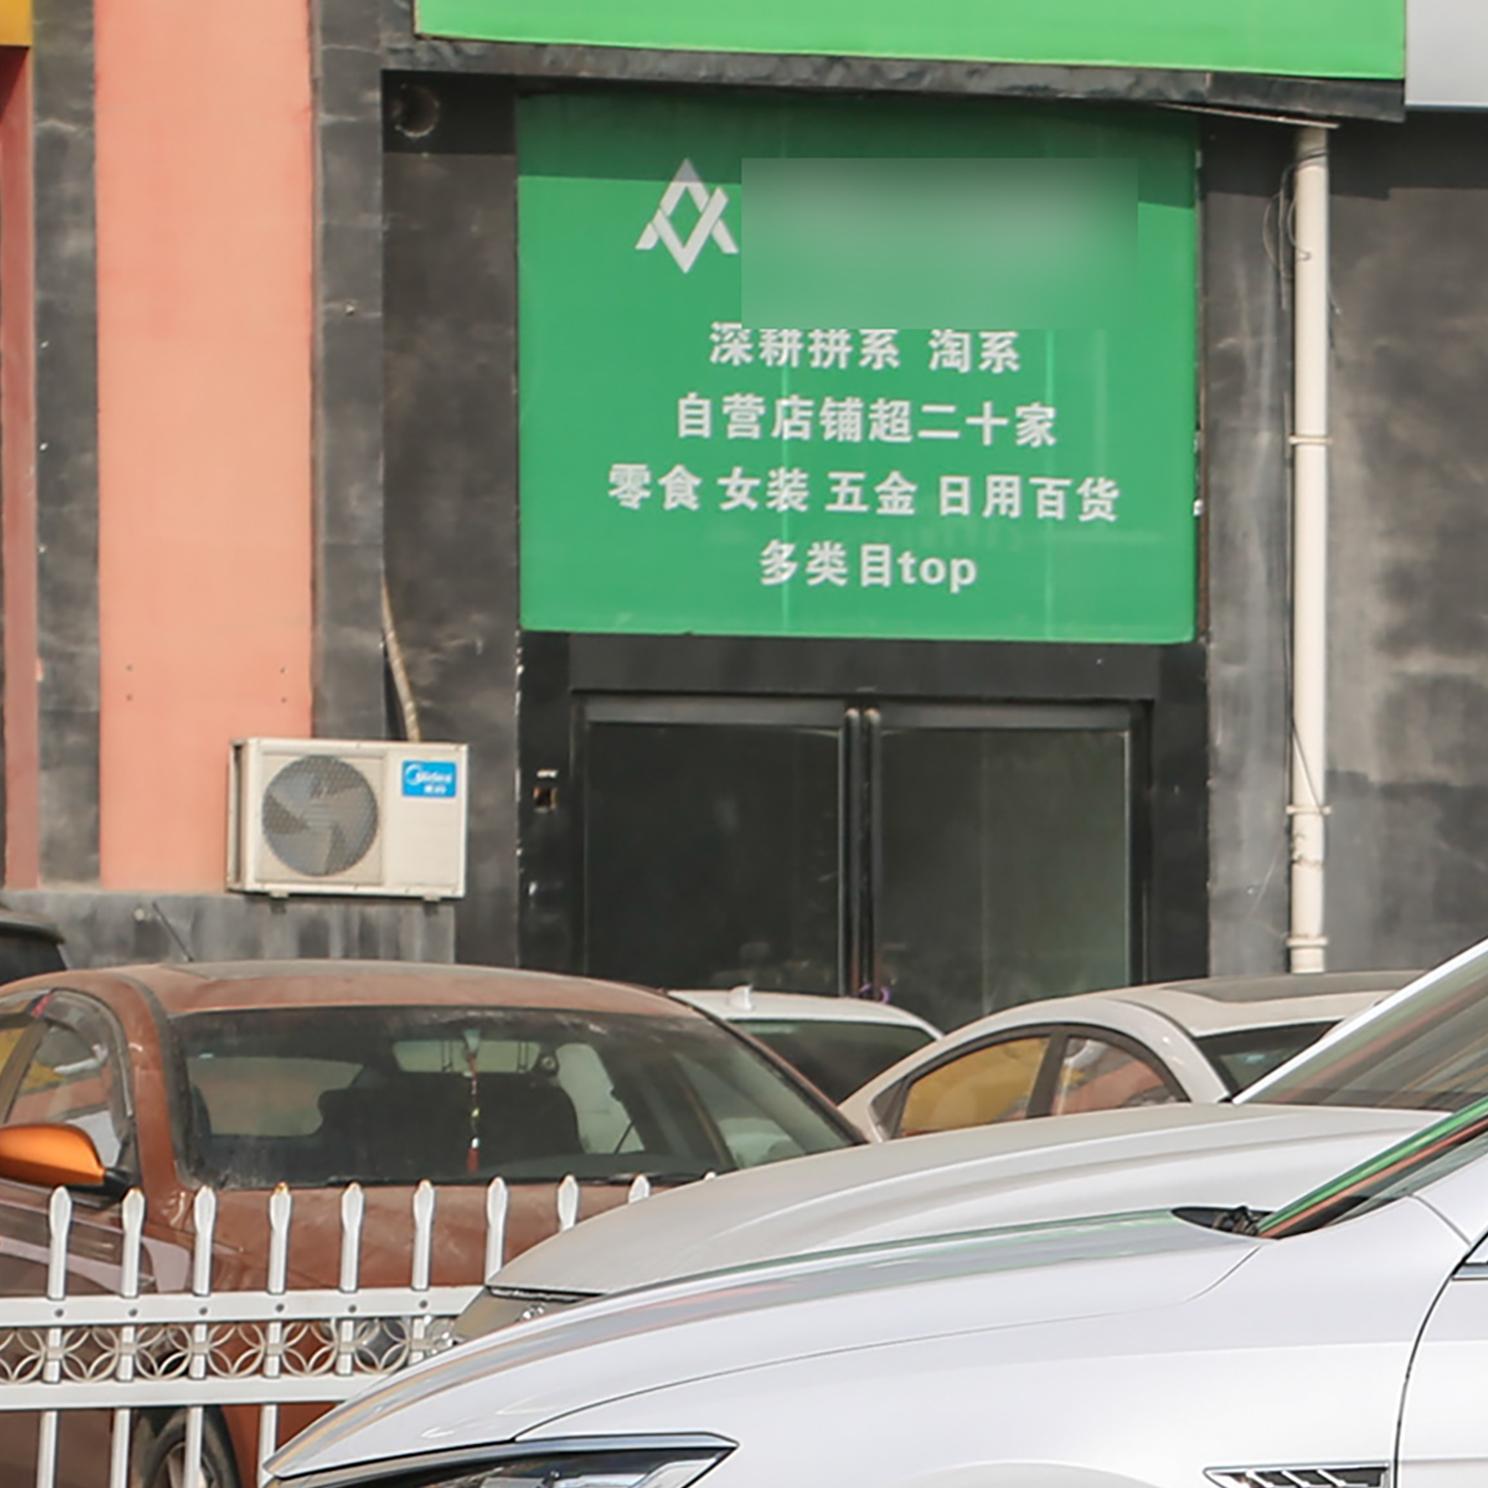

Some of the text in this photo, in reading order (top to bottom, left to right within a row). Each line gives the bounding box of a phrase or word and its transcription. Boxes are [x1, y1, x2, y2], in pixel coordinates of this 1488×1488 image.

[708, 321, 1021, 374] 深耕拼系 淘系
[677, 391, 1057, 448] 自营店铺超二十家
[608, 463, 1120, 523] 零食 女装 五金 日用百货
[760, 538, 978, 594] 多类目top
